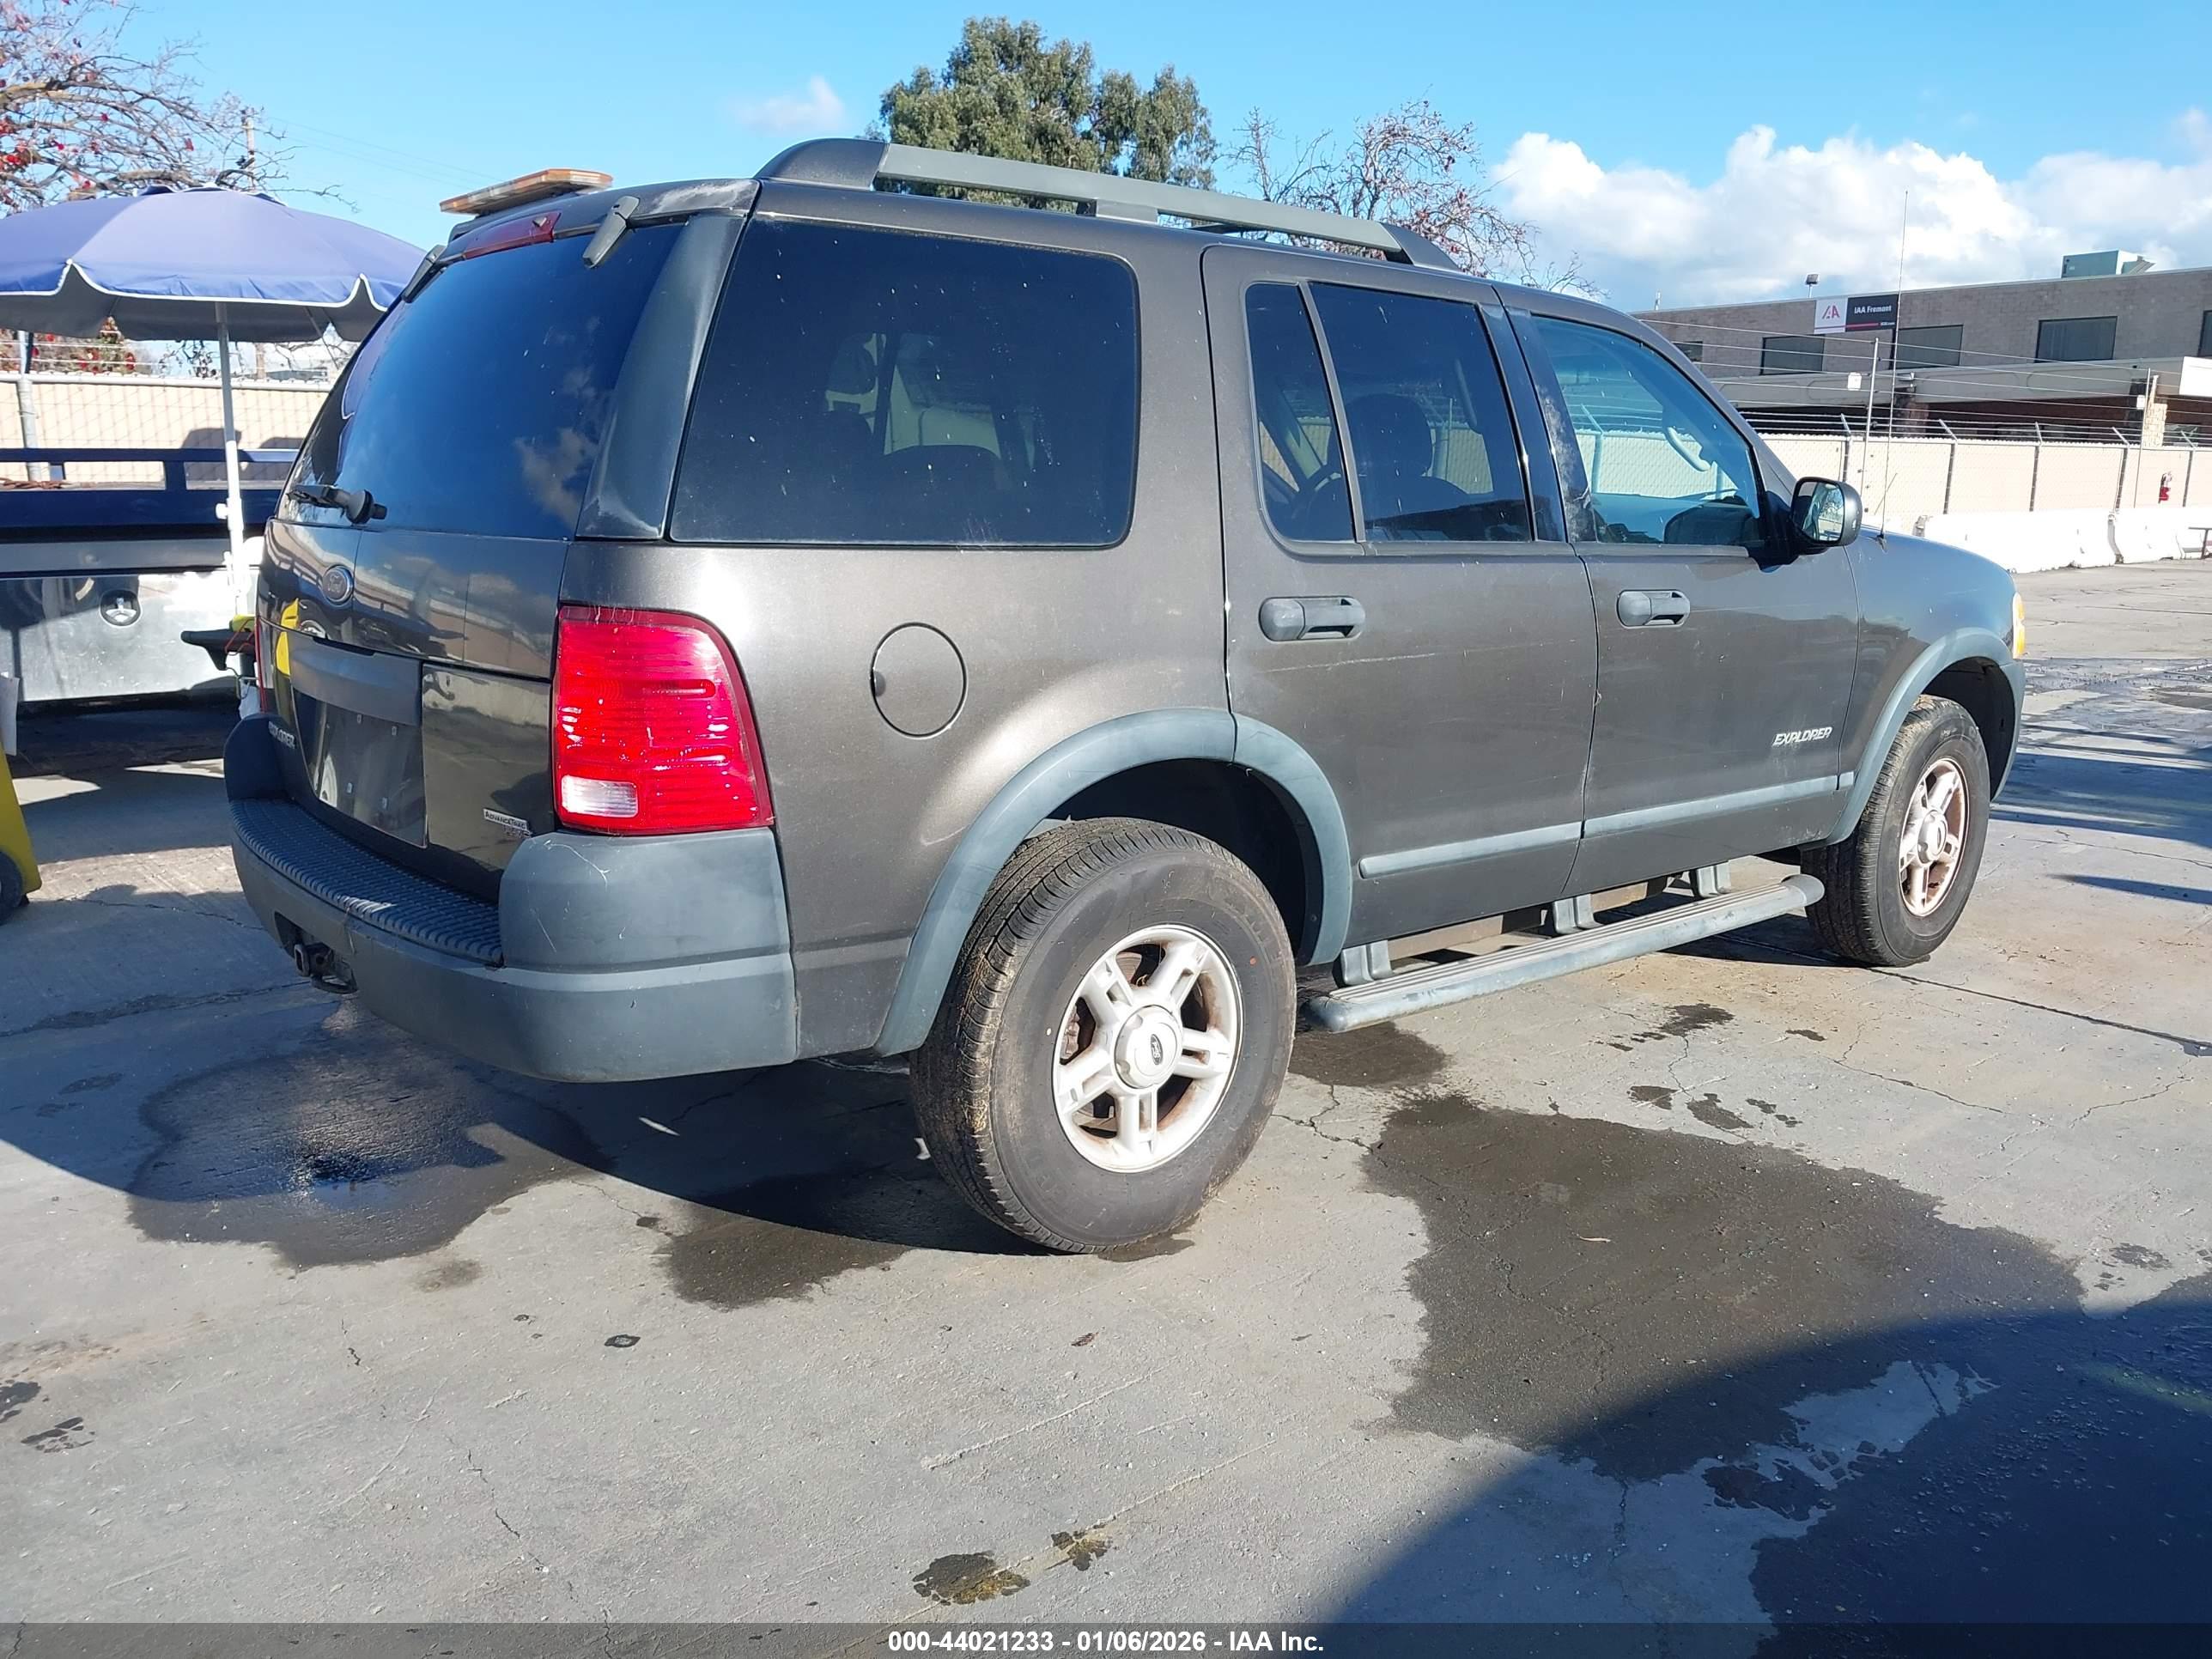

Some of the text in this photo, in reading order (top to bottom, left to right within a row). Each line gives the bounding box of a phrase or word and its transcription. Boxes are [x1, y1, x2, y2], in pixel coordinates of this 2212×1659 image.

[1854, 305, 1892, 314] IAA Fremont
[1771, 726, 1832, 747] EXPLORER
